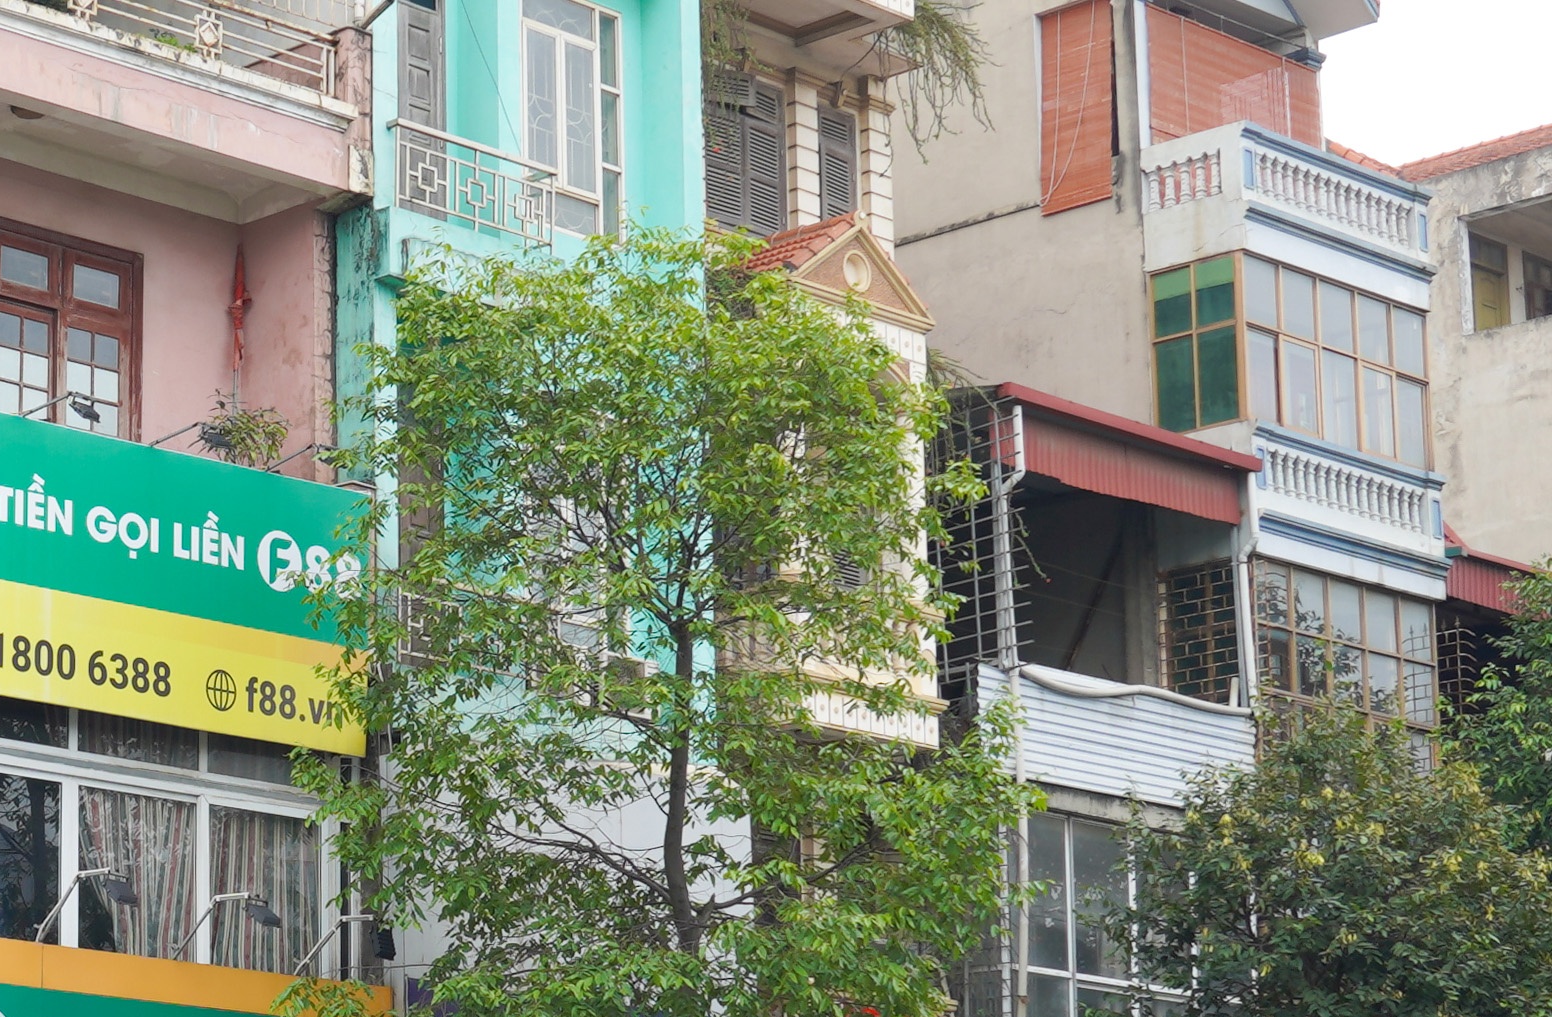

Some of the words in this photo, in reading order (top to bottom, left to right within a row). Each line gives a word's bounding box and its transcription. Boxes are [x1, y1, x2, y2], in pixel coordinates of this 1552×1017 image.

[86, 505, 160, 560] GỌI
[173, 511, 245, 570] LIỀN
[257, 530, 362, 600] F88
[88, 649, 172, 698] 6388
